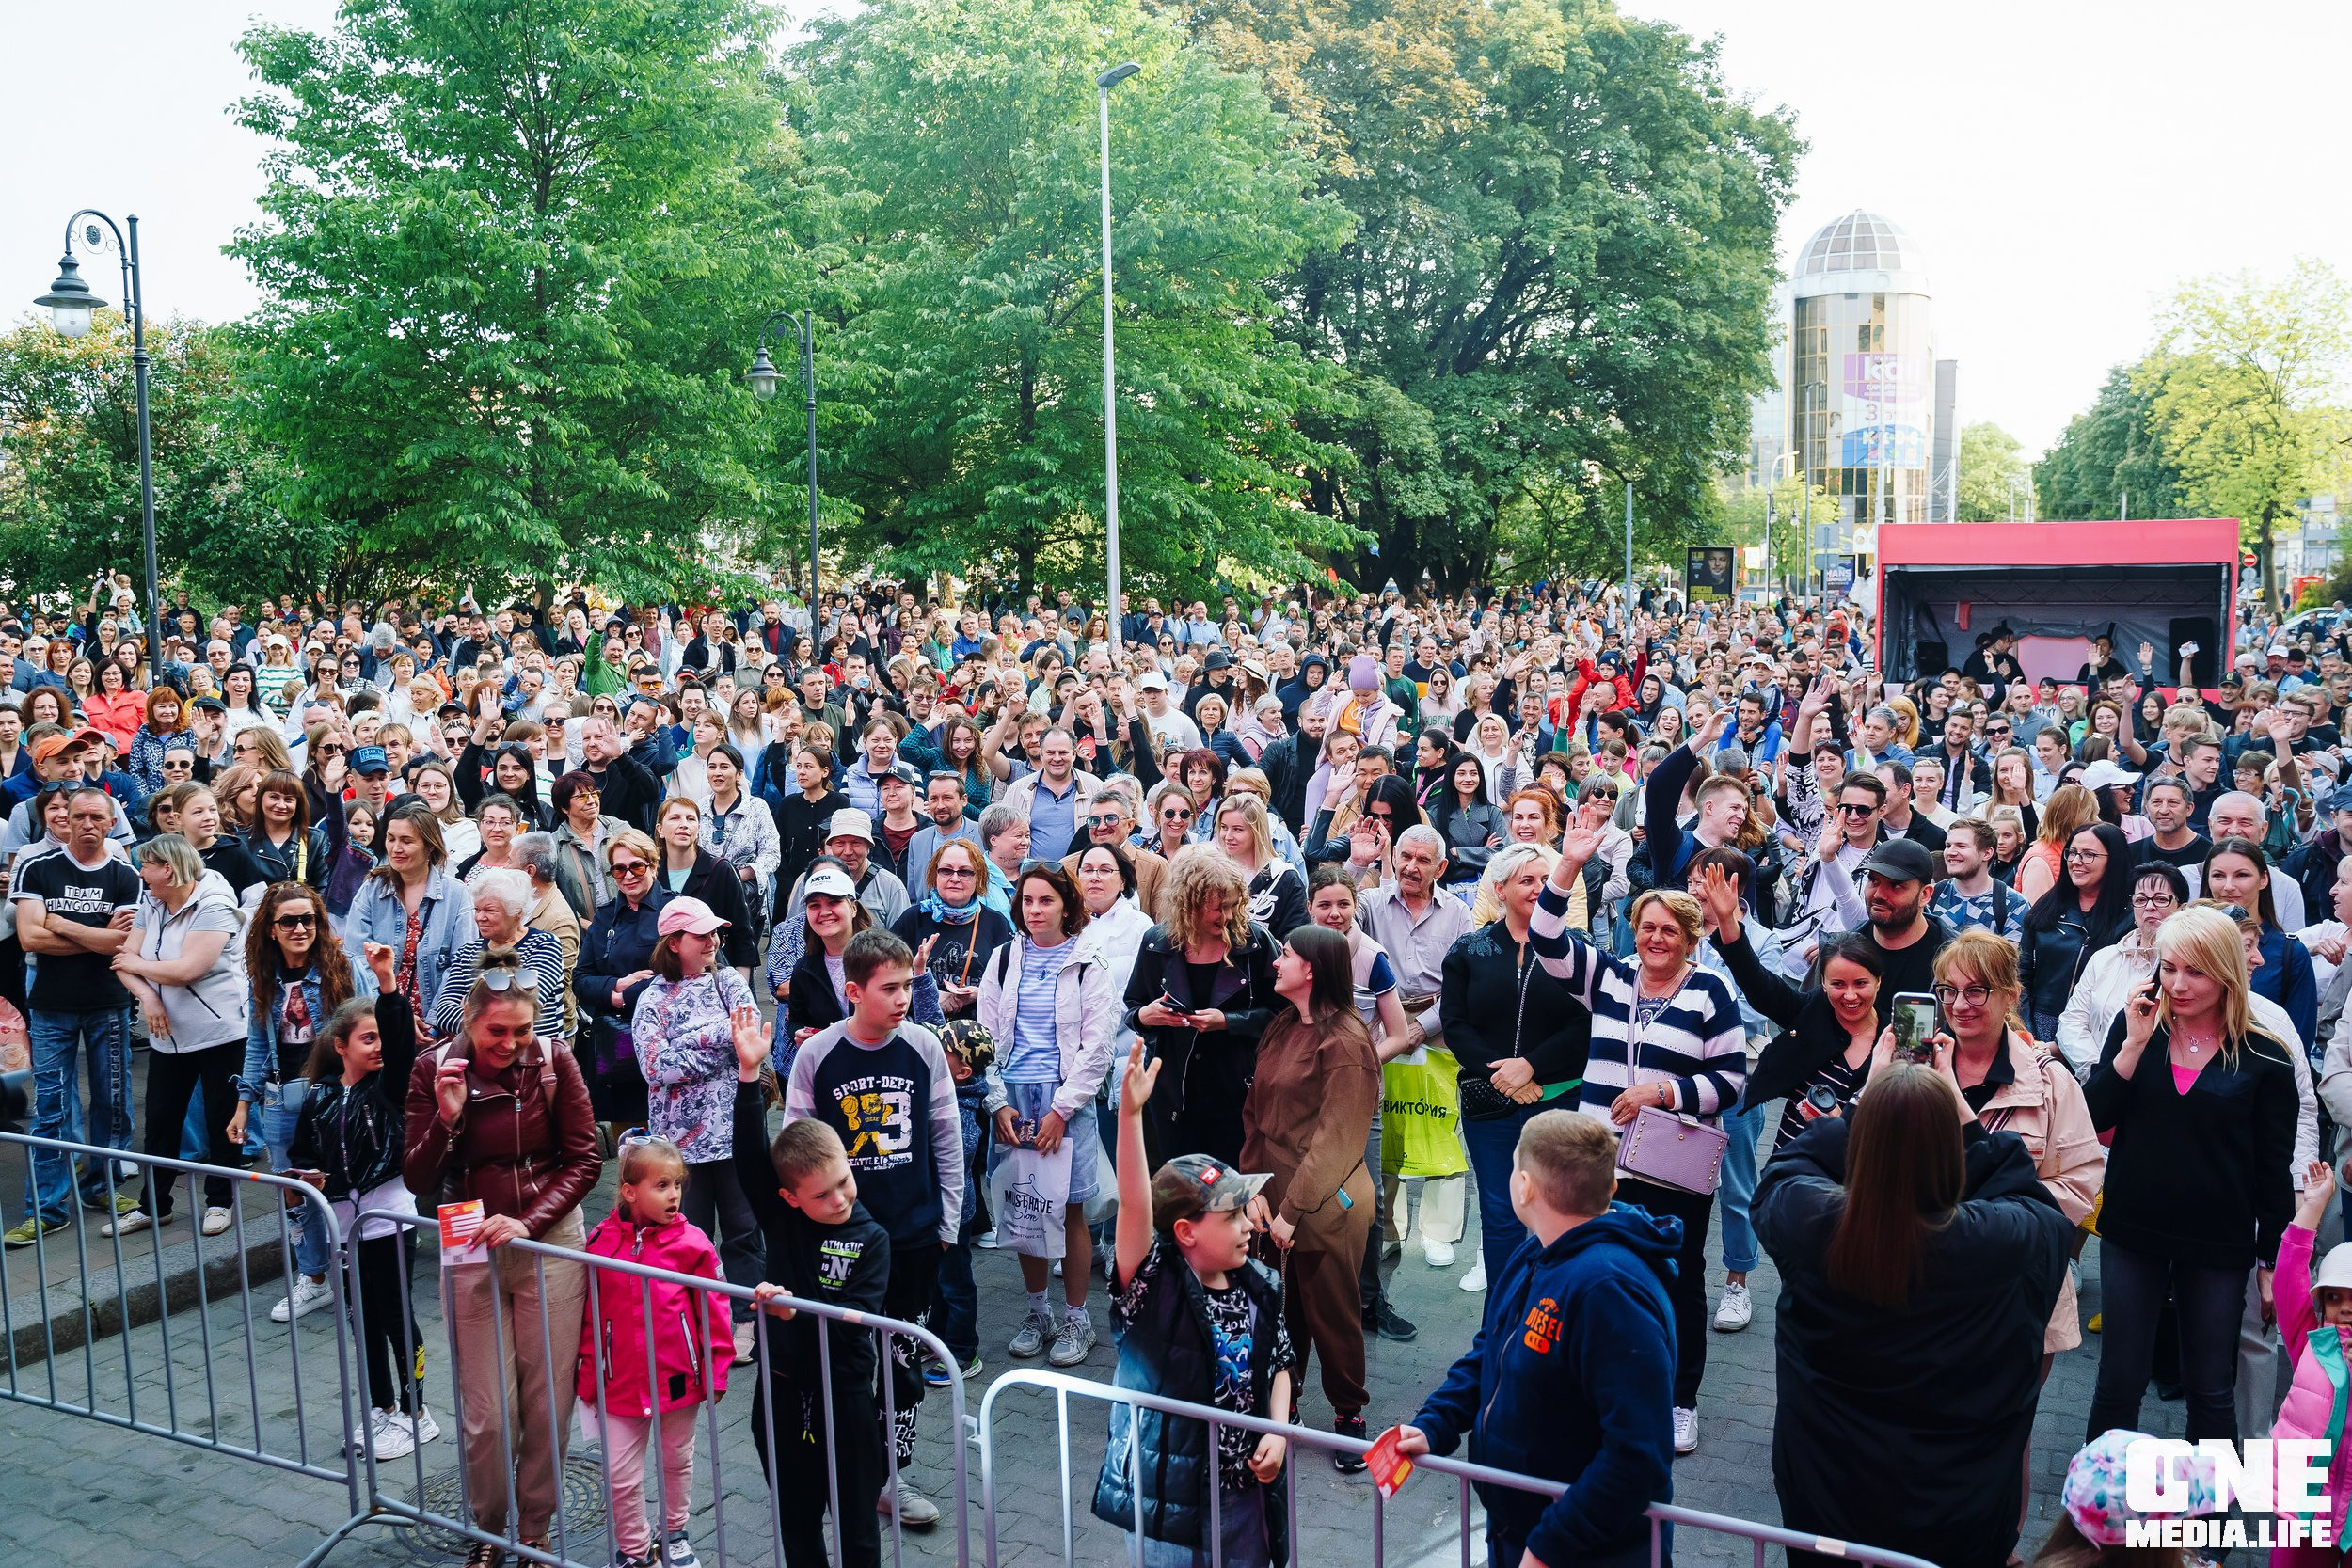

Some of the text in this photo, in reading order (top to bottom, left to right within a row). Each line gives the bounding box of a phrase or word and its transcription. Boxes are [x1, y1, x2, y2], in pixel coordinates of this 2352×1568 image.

[66, 886, 102, 900] TEAM
[833, 1076, 914, 1100] SPORT-DEPT.
[879, 1091, 912, 1150] 3
[848, 1156, 880, 1166] EATTLE
[1005, 1190, 1053, 1214] MUST HAVE
[821, 1240, 864, 1253] ATHLETIC
[827, 1255, 851, 1280] N
